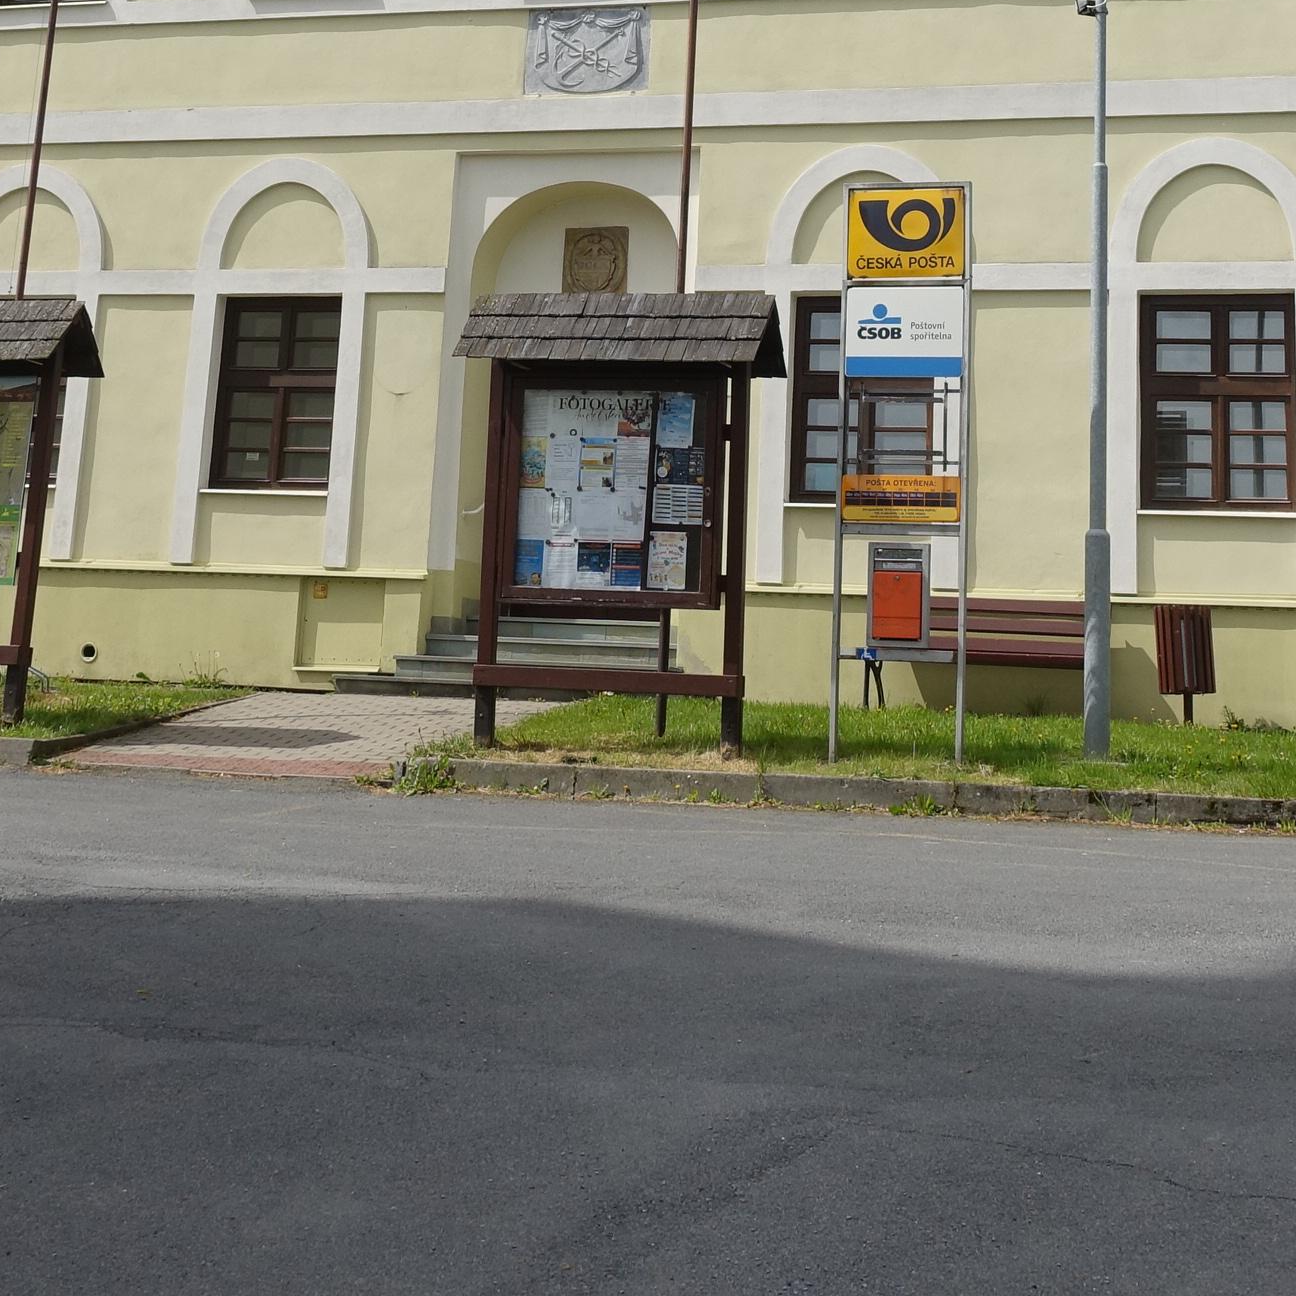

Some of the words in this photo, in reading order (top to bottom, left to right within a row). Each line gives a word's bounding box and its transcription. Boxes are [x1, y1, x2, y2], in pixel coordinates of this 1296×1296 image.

[856, 254, 903, 270] ČESKÁ
[908, 253, 955, 269] POŠTA
[910, 321, 945, 330] Poštovní
[857, 325, 902, 340] ČSOB
[910, 332, 952, 341] spořitelna
[865, 478, 891, 487] POŠTA
[893, 478, 937, 487] OTEVŘENA:
